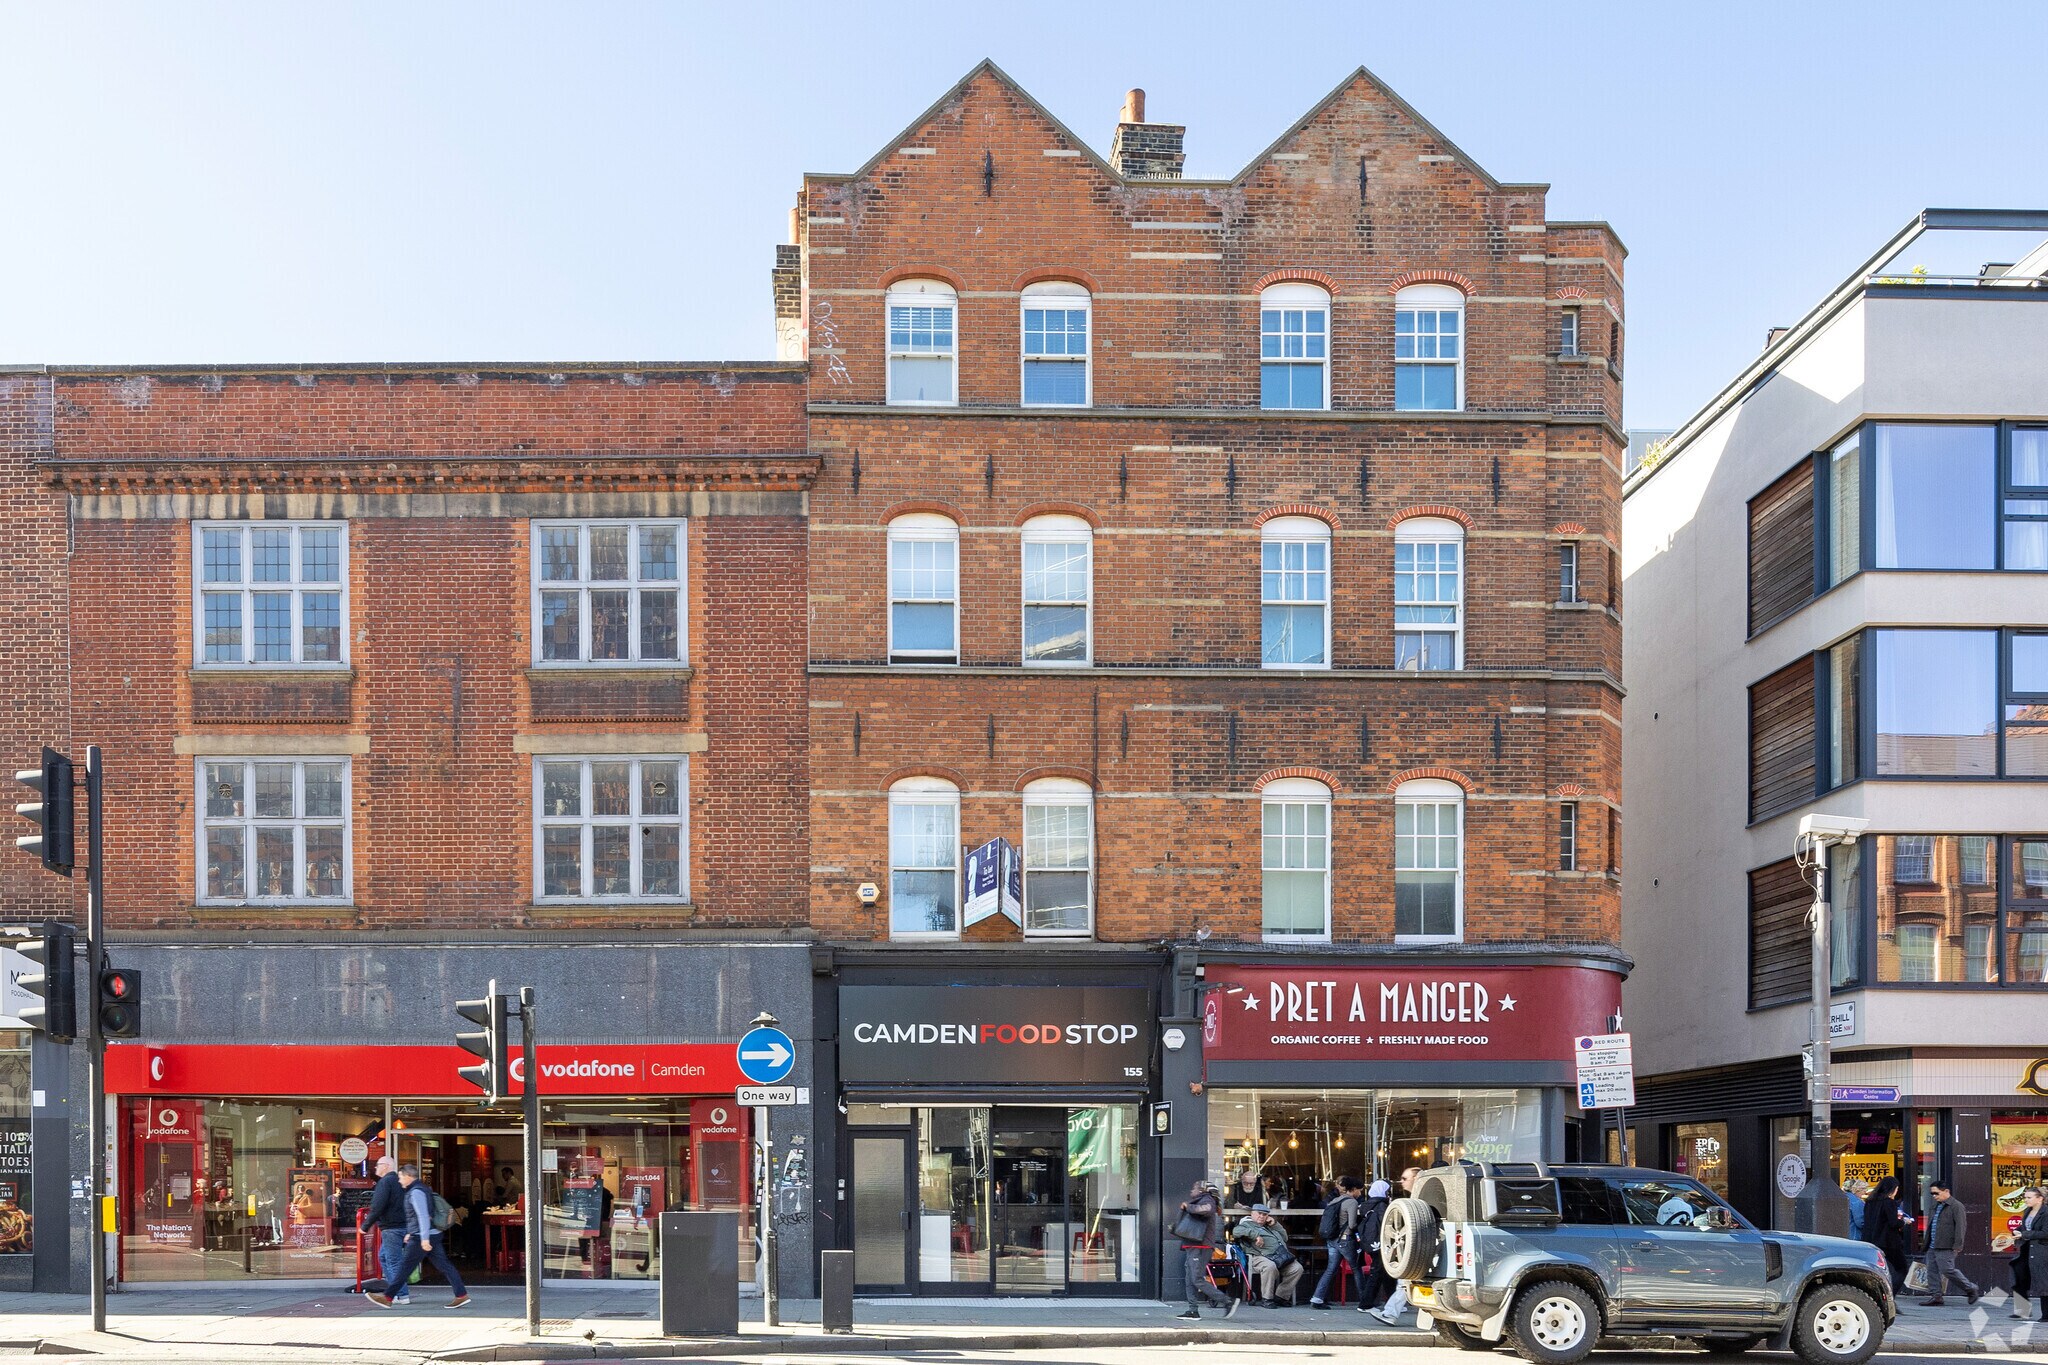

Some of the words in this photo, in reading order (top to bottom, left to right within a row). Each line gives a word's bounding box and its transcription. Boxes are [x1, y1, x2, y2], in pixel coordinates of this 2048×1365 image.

[1270, 981, 1337, 1022] PRET
[1348, 982, 1366, 1022] A
[1380, 981, 1490, 1022] MANGER
[854, 1022, 977, 1044] CAMDEN
[980, 1023, 1061, 1044] FOOD
[1065, 1023, 1138, 1044] STOP
[1271, 1035, 1320, 1045] ORGANIC
[1321, 1035, 1361, 1045] COFFEE
[1379, 1036, 1423, 1045] FRESHLY
[1424, 1036, 1456, 1045] MADE
[1457, 1036, 1489, 1045] FOOD
[541, 1059, 635, 1077] vodafone
[651, 1063, 705, 1076] Camden
[1124, 1067, 1143, 1077] 155
[742, 1091, 765, 1100] One
[768, 1093, 792, 1102] way
[1479, 1134, 1499, 1142] New
[1465, 1141, 1513, 1158] Super
[293, 1174, 329, 1182] PRO
[1782, 1174, 1801, 1184] Google
[1997, 1170, 2037, 1178] REALLY
